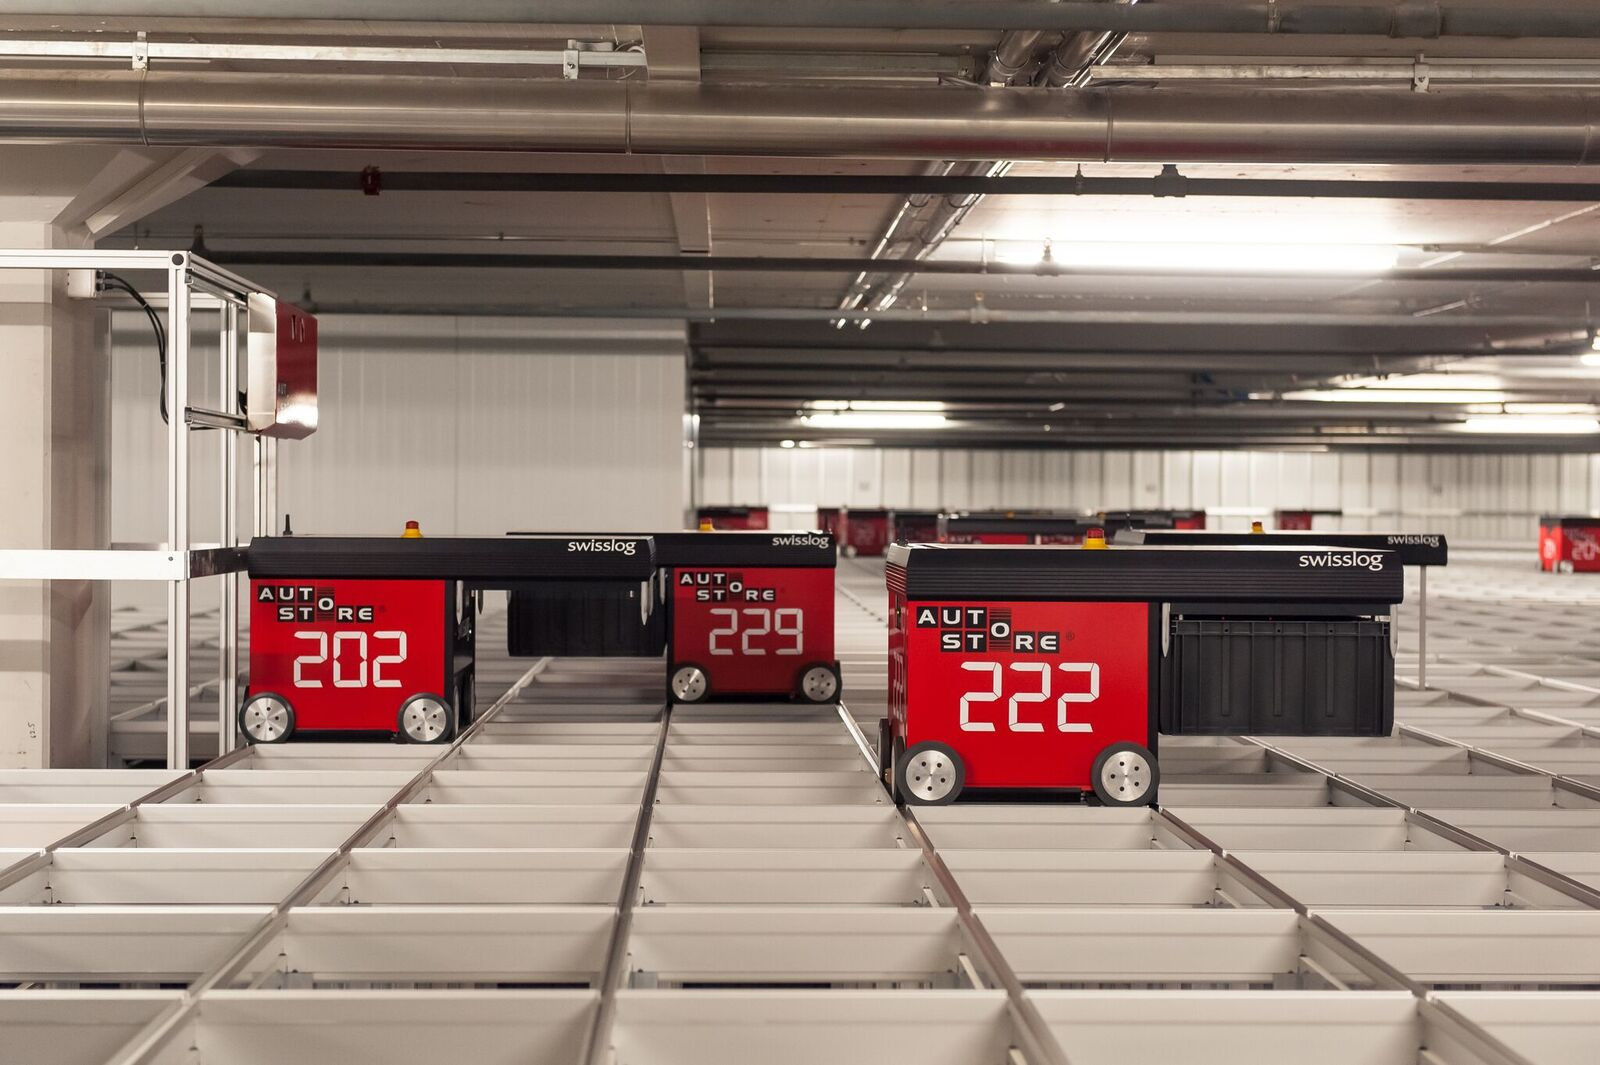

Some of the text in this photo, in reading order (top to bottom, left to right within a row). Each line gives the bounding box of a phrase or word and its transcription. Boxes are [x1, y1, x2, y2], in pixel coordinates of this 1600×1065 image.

[567, 540, 636, 556] swisslog
[771, 535, 830, 550] swisslog
[1387, 535, 1439, 548] swisslog
[1298, 551, 1383, 571] swisslog
[708, 608, 804, 655] 229
[293, 630, 407, 688] 202
[959, 661, 1100, 733] 222
